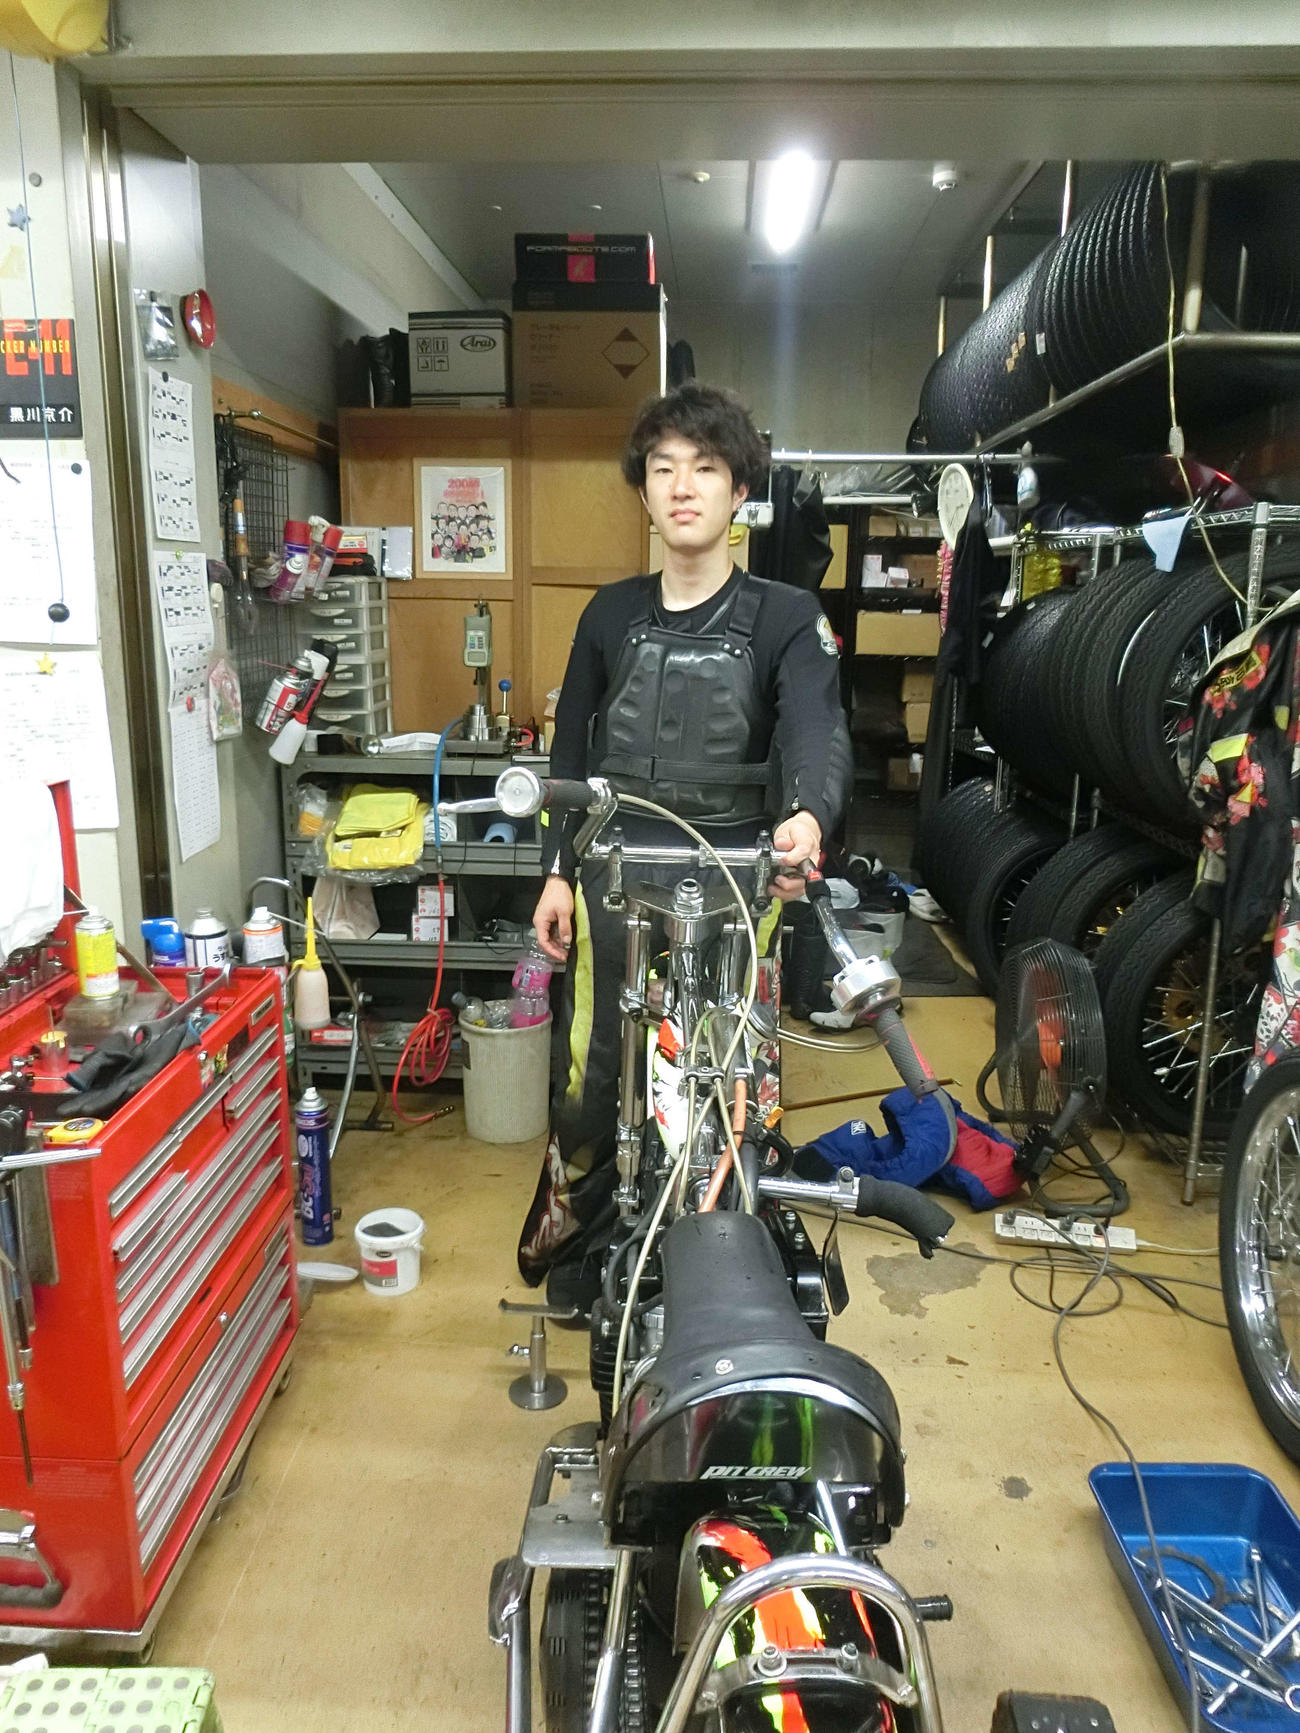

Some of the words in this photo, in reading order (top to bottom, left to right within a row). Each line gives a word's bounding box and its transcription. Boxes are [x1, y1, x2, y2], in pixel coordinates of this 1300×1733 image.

[463, 335, 492, 348] Arai
[9, 406, 73, 423] 黒川京介
[700, 1466, 743, 1479] PIT
[745, 1466, 812, 1478] CREW
